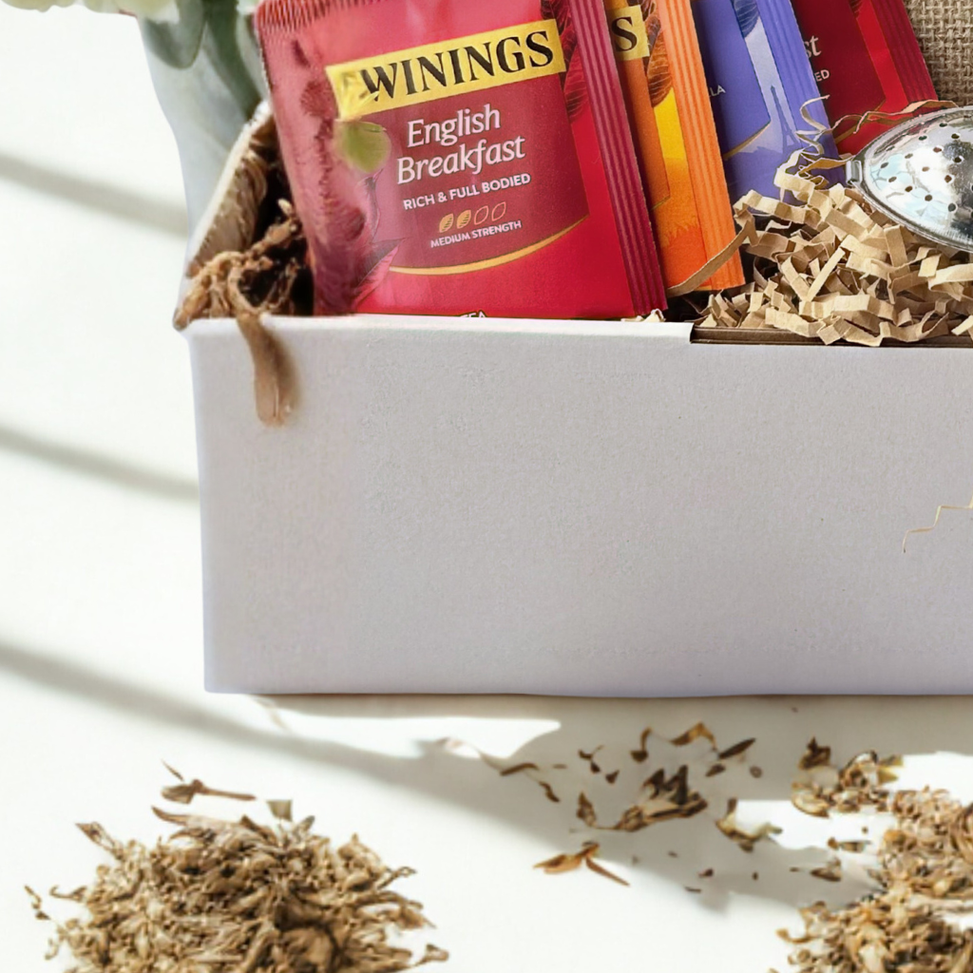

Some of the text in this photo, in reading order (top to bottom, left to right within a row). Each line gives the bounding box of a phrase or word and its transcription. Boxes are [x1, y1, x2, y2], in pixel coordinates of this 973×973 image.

[343, 30, 554, 102] WININGS
[407, 103, 501, 148] English
[397, 135, 526, 185] Breakfast
[403, 173, 532, 210] RICH & FULL BODIED
[430, 220, 522, 248] MEDIUM STRENGTH
